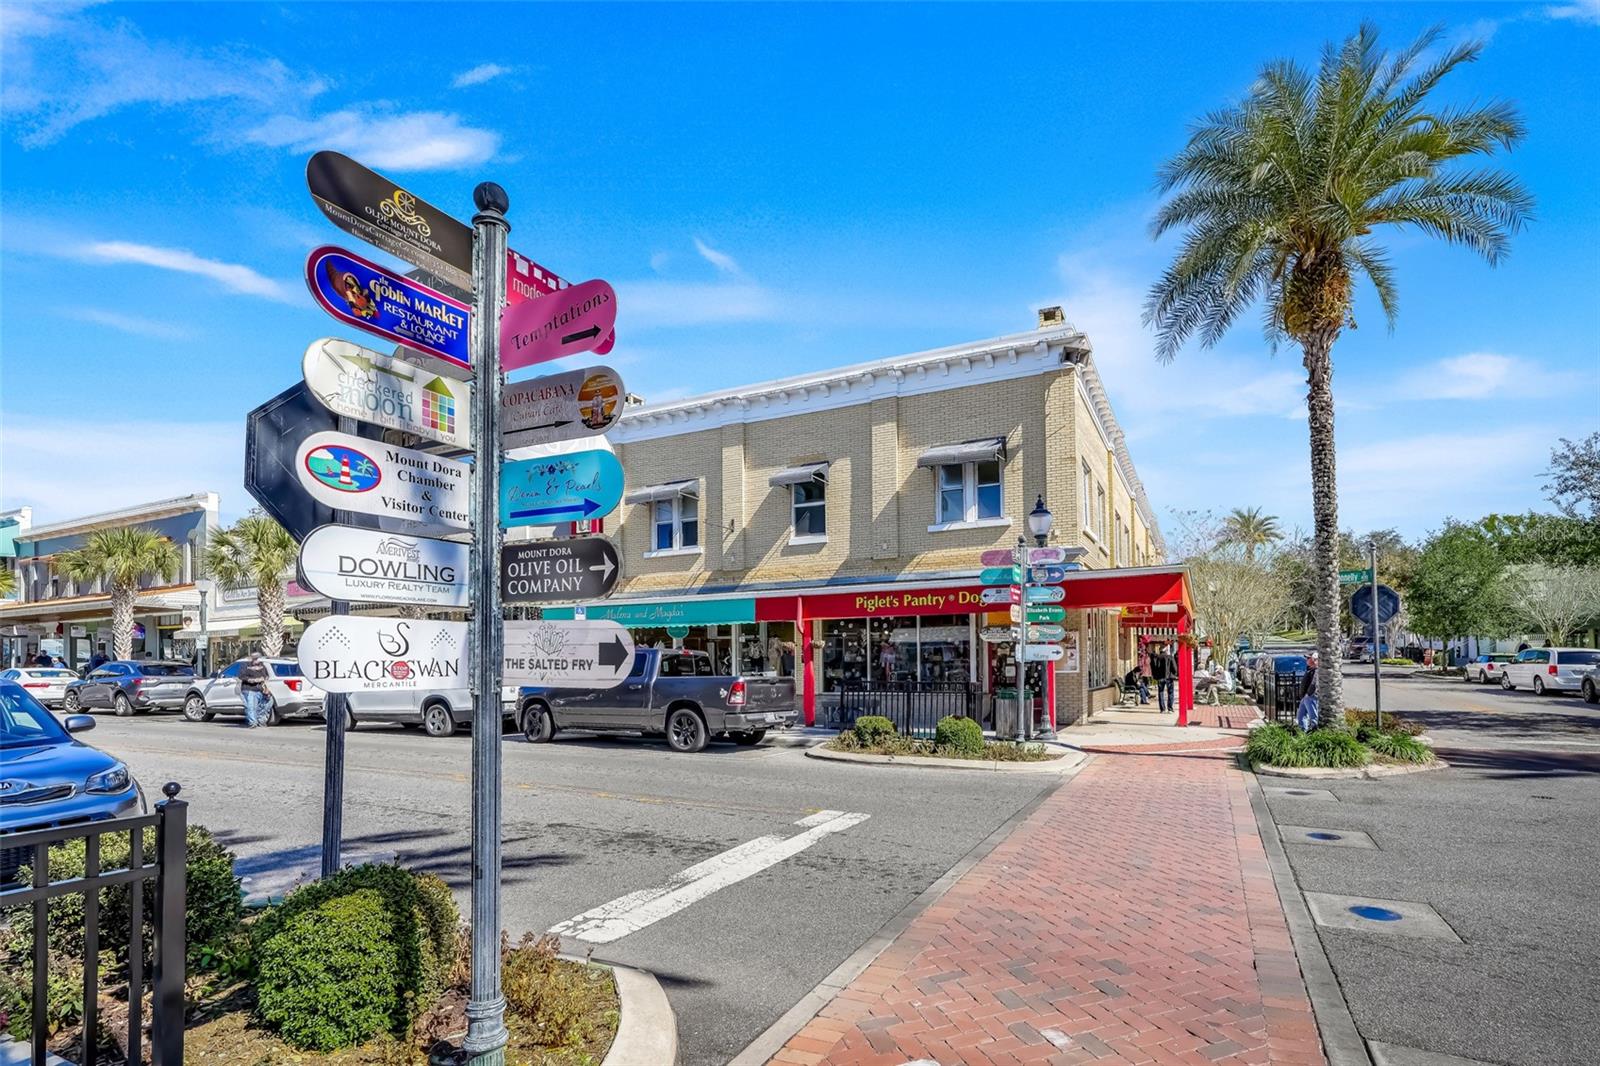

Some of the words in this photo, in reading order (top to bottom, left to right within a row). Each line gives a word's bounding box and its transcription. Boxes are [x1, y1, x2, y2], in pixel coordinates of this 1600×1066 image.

[365, 206, 388, 224] OLDE
[391, 218, 419, 239] MOUNT
[421, 236, 441, 252] DORA
[384, 301, 459, 340] RESTAURANT
[400, 319, 408, 330] &
[411, 323, 446, 346] LOUNGE
[511, 293, 610, 350] Temptations
[338, 371, 414, 405] checkered
[502, 383, 575, 408] COPACABANA
[339, 384, 414, 423] moon
[337, 402, 368, 418] home
[441, 433, 456, 443] you
[385, 450, 429, 471] Mount
[433, 461, 462, 478] Dora
[397, 469, 456, 491] Chamber
[421, 490, 433, 502] &
[381, 496, 426, 515] Visitor
[429, 505, 469, 522] Center
[518, 549, 548, 559] MOUNT
[549, 547, 572, 557] DORA
[339, 555, 455, 582] DOWLING
[507, 560, 551, 577] OLIVE
[555, 558, 583, 574] OIL
[345, 578, 385, 590] LUXURY
[388, 580, 424, 594] REALTY
[426, 584, 450, 594] TEAM
[507, 577, 584, 595] COMPANY
[855, 595, 899, 612] Piglet's
[903, 594, 945, 609] Pantry
[313, 659, 392, 682] BLACK
[408, 657, 460, 680] SWAN
[505, 658, 525, 670] THE
[528, 658, 568, 670] SALTED
[571, 659, 594, 671] FRY
[364, 680, 417, 688] MERCANTILE
